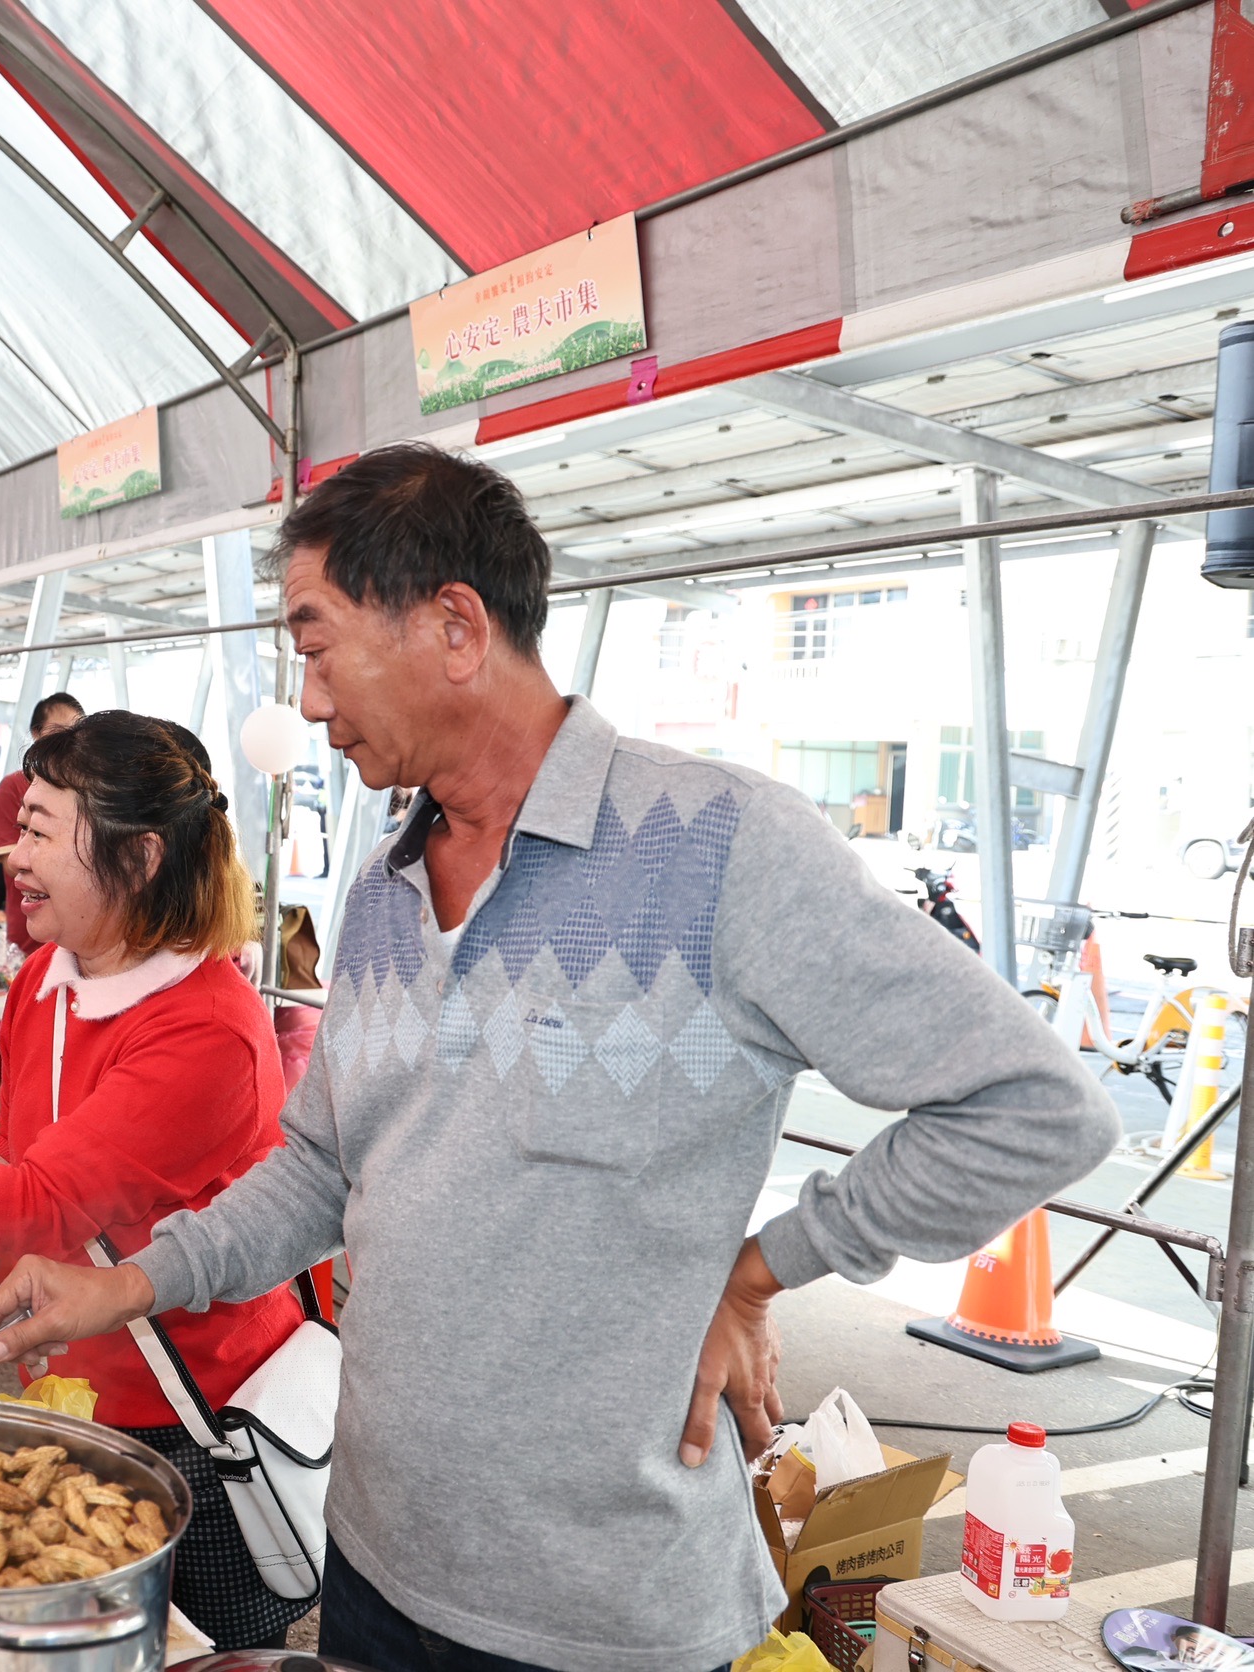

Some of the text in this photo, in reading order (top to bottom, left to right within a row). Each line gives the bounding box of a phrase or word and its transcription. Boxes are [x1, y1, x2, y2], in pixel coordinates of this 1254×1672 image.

[835, 1540, 905, 1576] 烤肉香烤肉公司
